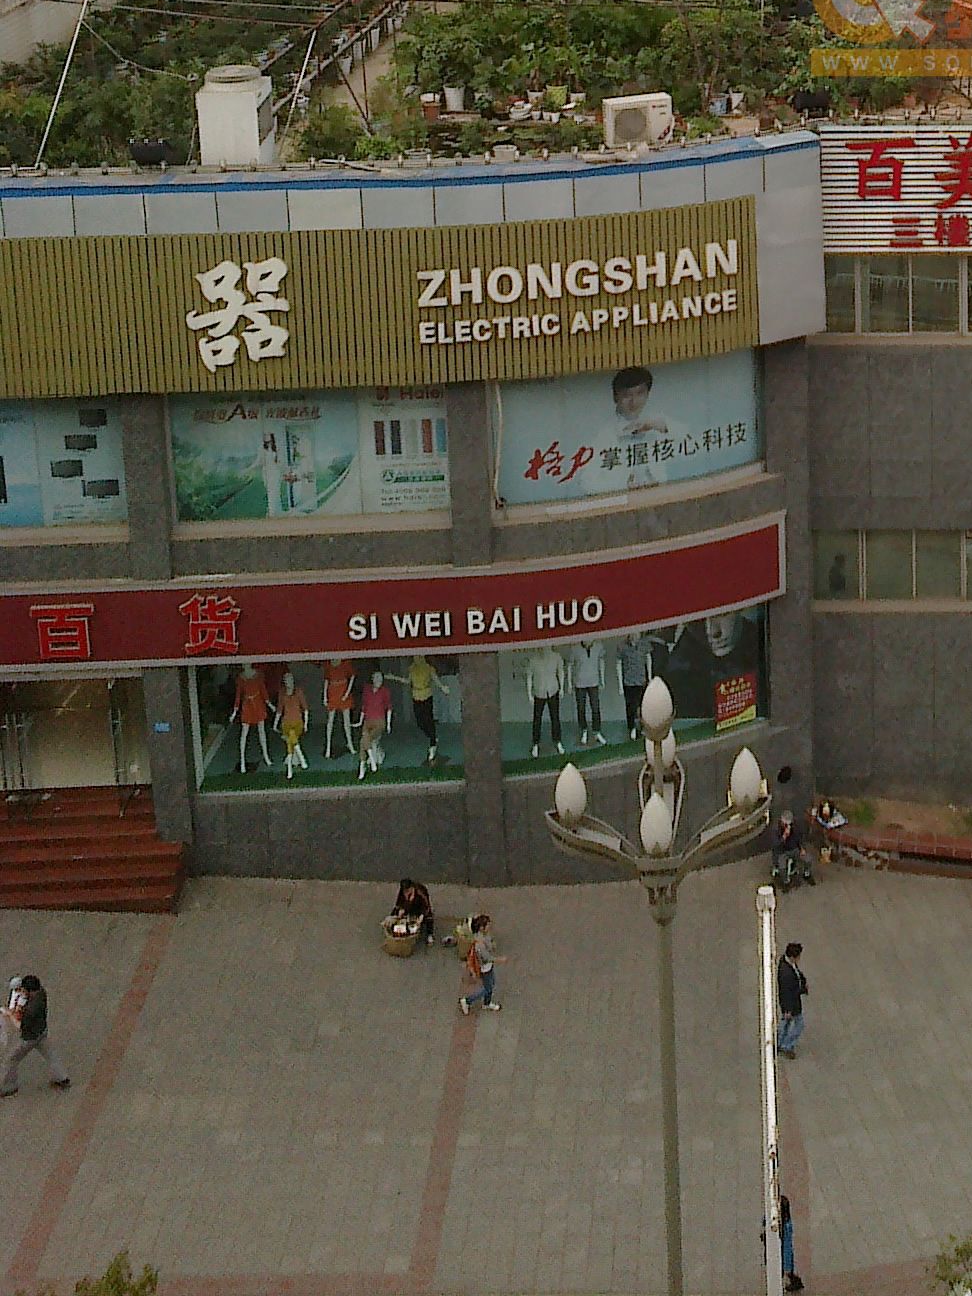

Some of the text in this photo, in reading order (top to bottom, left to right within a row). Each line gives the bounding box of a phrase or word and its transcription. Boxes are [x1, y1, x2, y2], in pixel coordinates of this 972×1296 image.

[417, 239, 738, 308] ZHONGSHAN
[186, 256, 291, 373] 器
[419, 289, 738, 344] ELECTRIC APPLIANCE
[600, 421, 747, 471] 掌握核心科技
[29, 592, 241, 659] 百货
[348, 595, 604, 641] SI WEI BAI HUO
